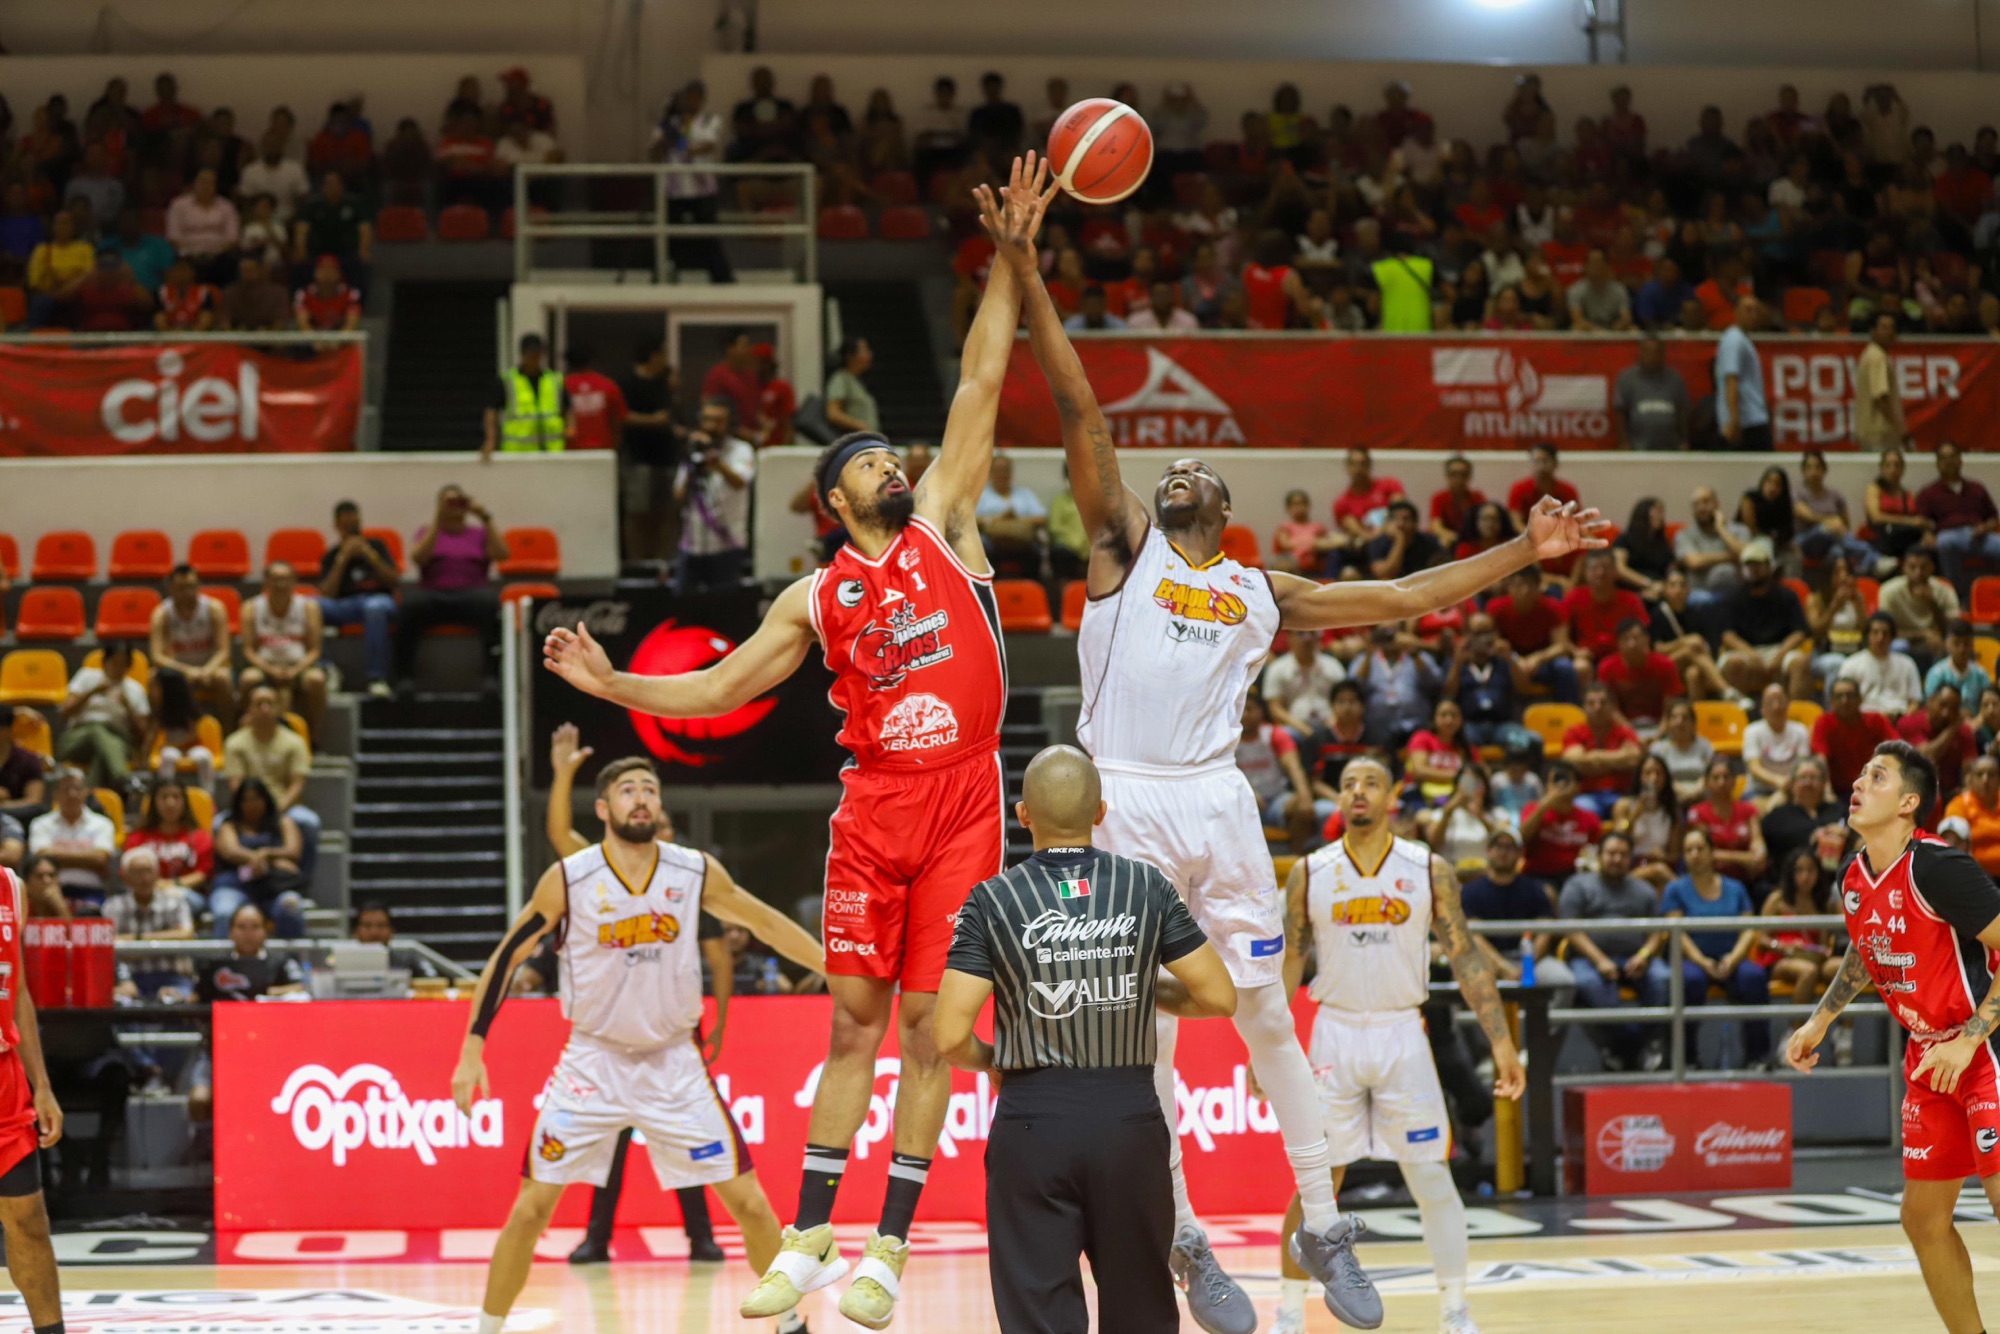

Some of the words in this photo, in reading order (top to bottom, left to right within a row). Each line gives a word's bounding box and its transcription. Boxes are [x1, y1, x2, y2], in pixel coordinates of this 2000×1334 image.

[1773, 354, 1961, 400] POER
[102, 349, 260, 443] ciel
[1775, 401, 1860, 443] AD
[911, 571, 927, 592] 1
[881, 728, 959, 750] VERACRUZ
[829, 889, 858, 902] FOUR
[828, 901, 866, 916] POINTS
[1021, 909, 1136, 949] Caliente
[1887, 915, 1907, 934] 44
[1053, 945, 1135, 962] caliente.mx
[1029, 973, 1138, 1015] VALUE
[1902, 1145, 1934, 1161] mex
